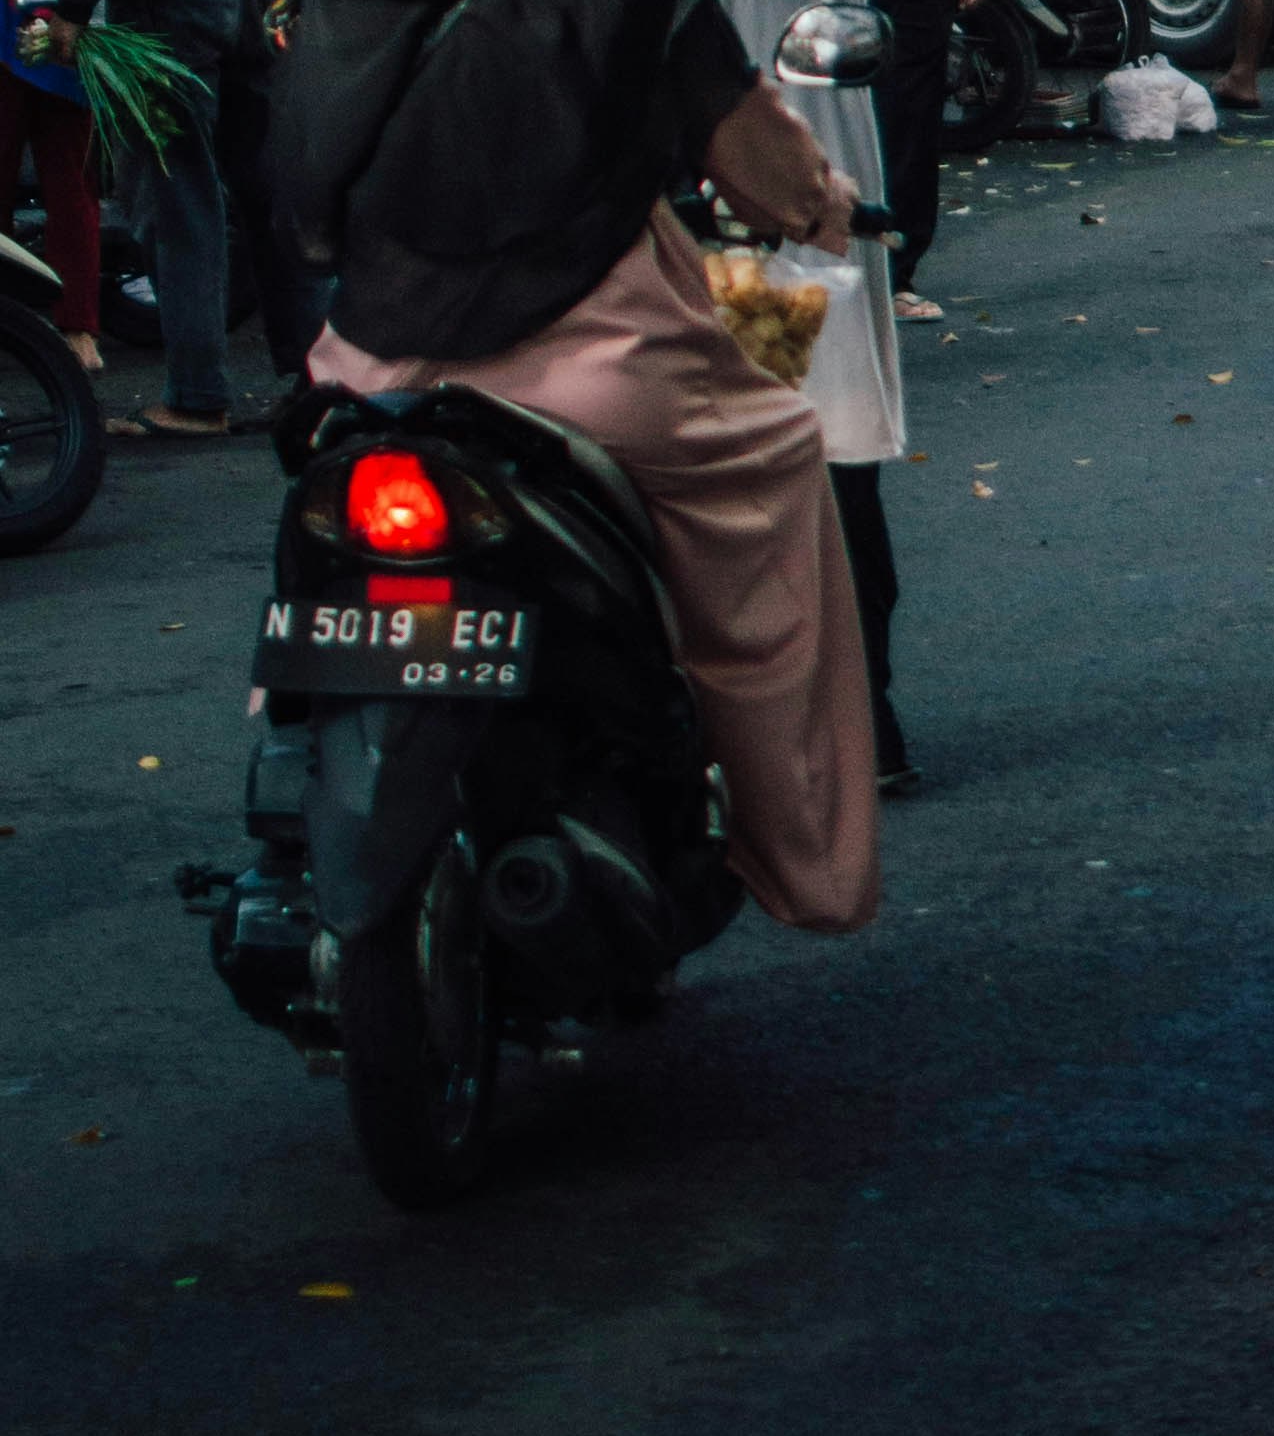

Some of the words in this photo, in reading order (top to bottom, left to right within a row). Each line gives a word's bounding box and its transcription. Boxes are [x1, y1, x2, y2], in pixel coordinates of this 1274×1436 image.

[264, 602, 294, 639] N
[312, 607, 415, 647] 5019
[452, 610, 525, 649] ECI
